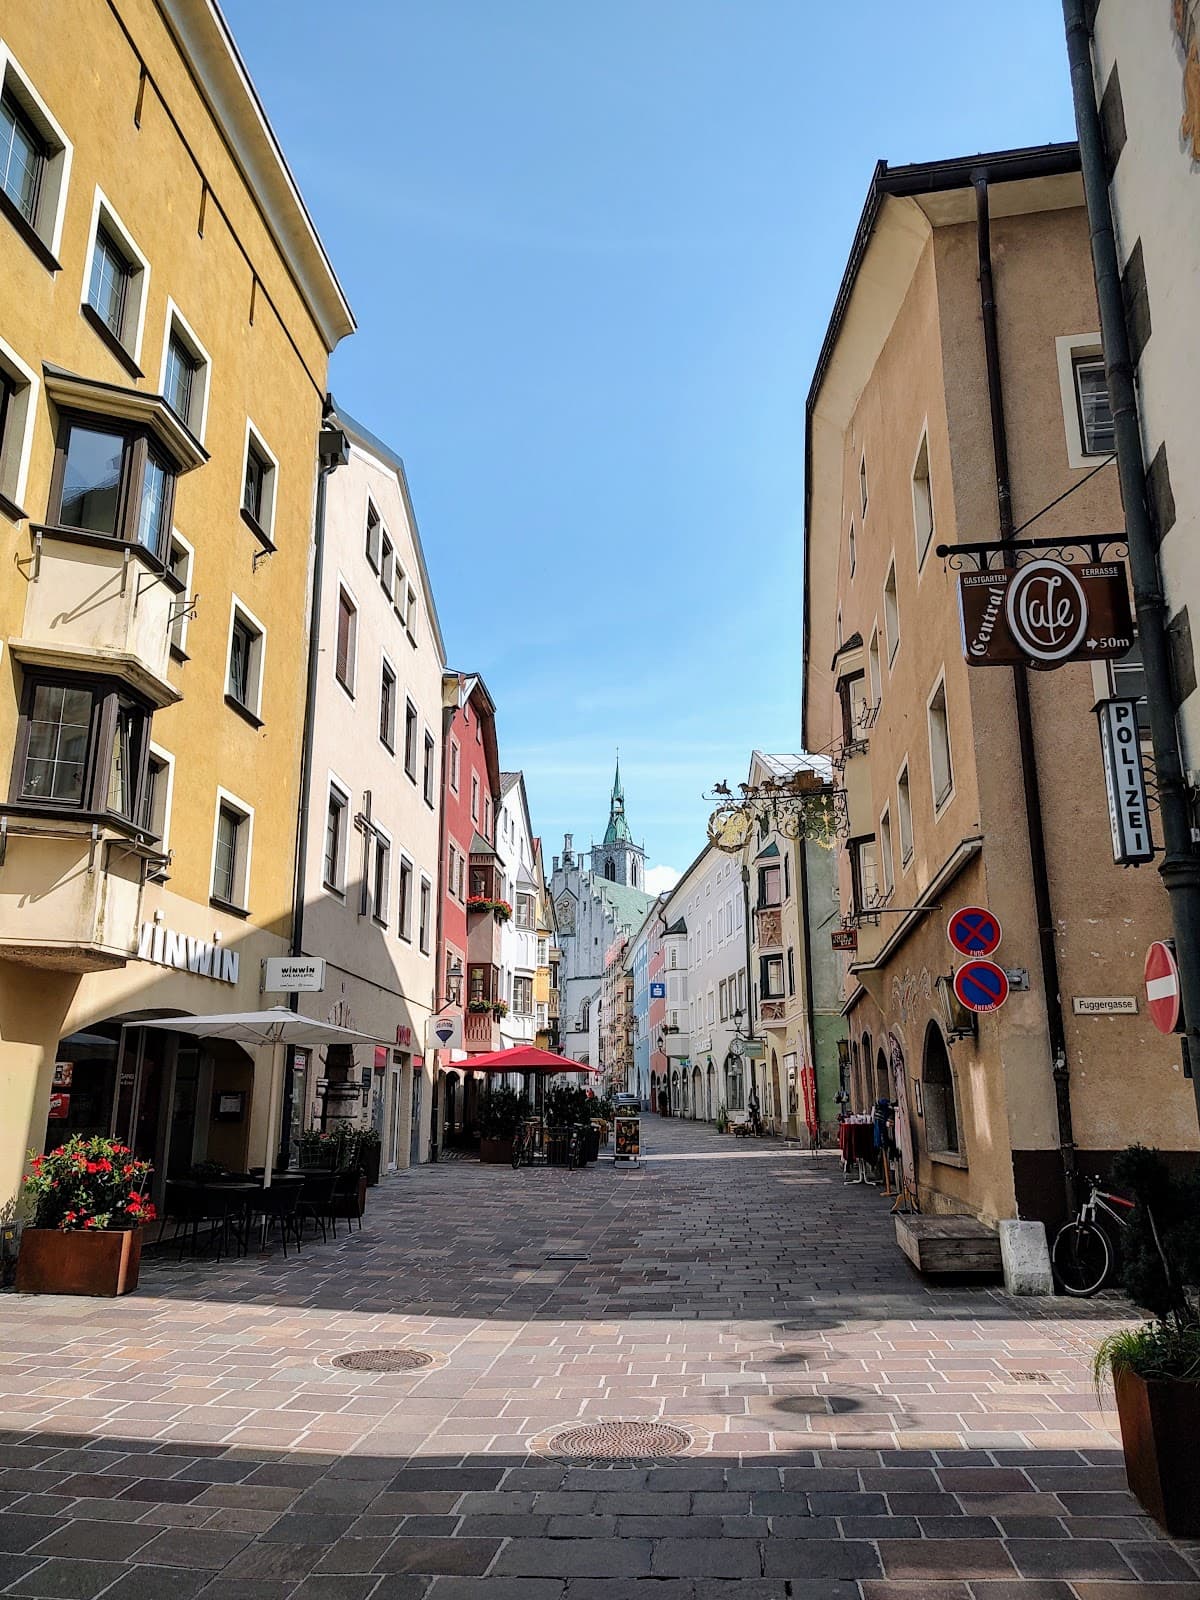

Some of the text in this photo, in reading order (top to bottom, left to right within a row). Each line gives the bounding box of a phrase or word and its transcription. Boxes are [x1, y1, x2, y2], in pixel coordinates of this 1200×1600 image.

[1081, 567, 1118, 576] TERRASSE
[963, 574, 1008, 585] GASTGARTEN
[970, 587, 1005, 656] Central
[1099, 637, 1130, 648] 50m
[1115, 706, 1143, 851] POLIZEI
[973, 1001, 997, 1011] ANFANG
[1079, 1000, 1133, 1010] Fuggergasse
